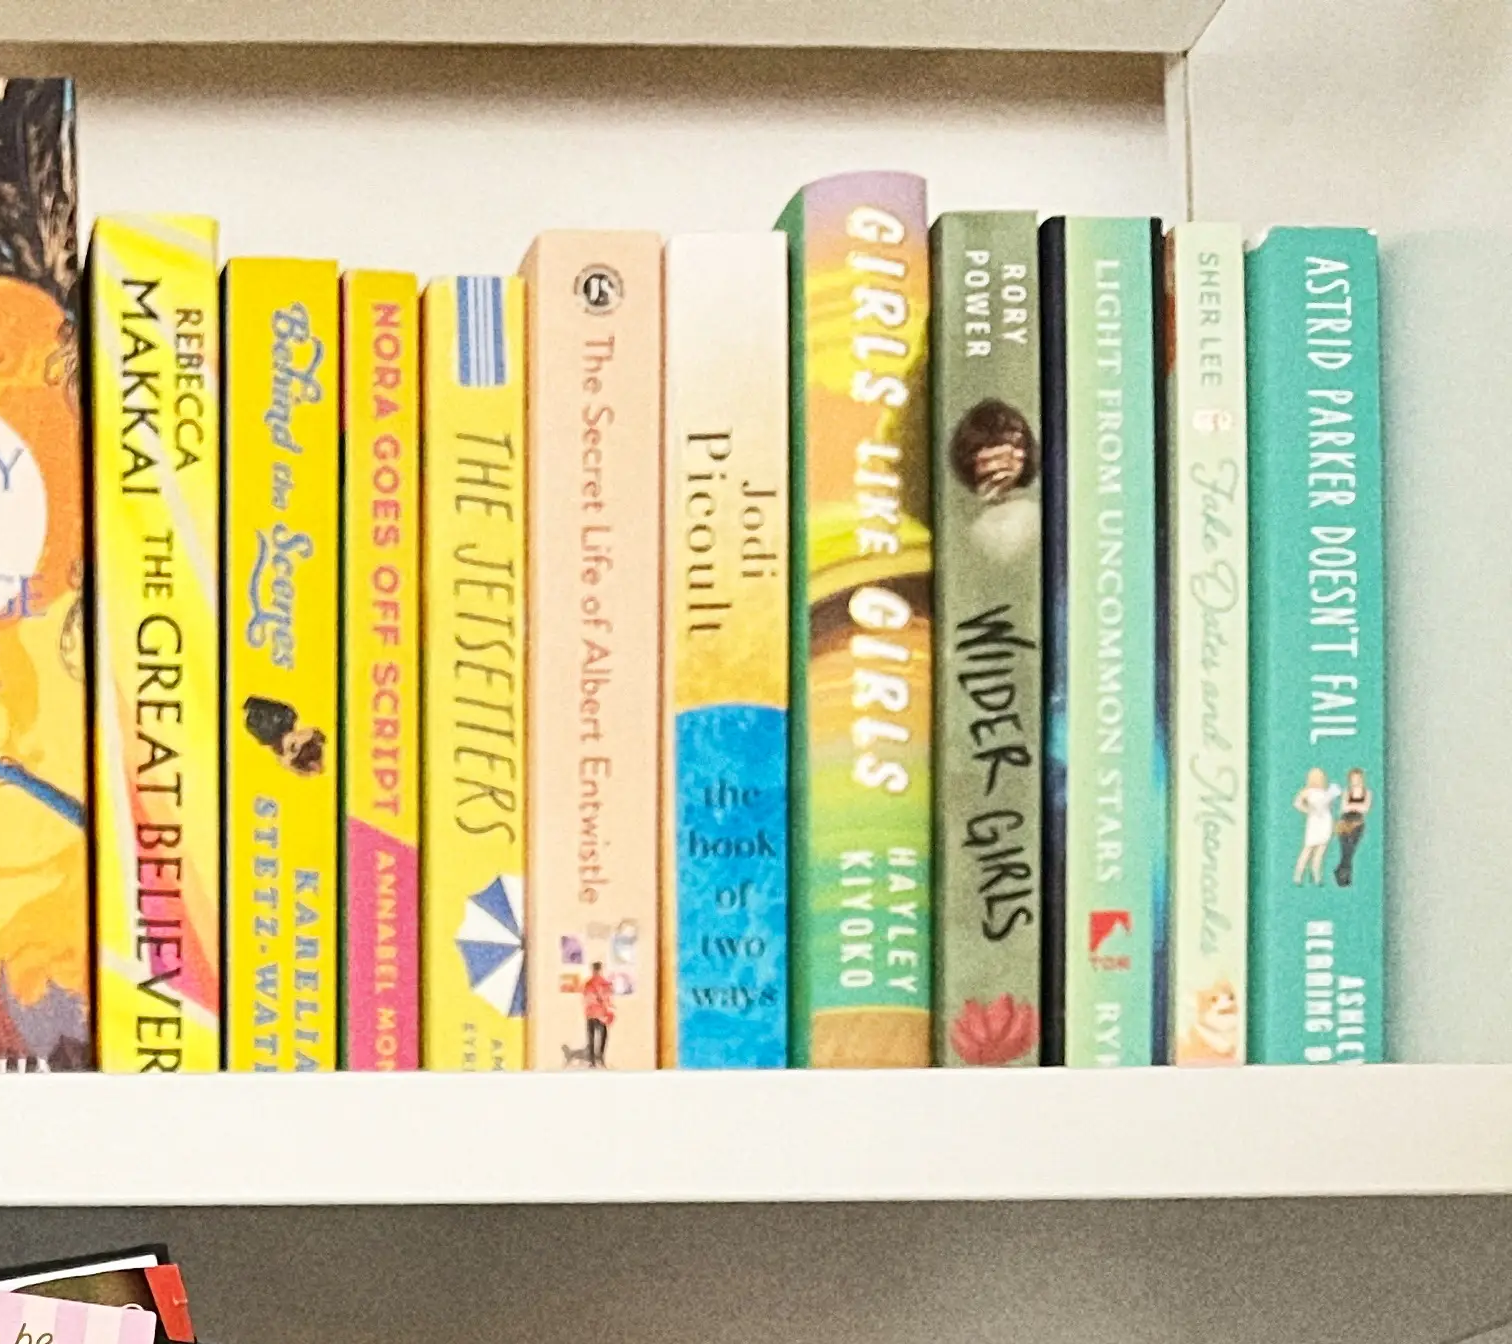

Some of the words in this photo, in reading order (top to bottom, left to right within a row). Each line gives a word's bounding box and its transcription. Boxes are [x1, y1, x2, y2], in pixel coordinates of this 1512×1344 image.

[845, 206, 910, 409] GIRLS
[964, 249, 993, 358] POWER
[1001, 262, 1029, 347] RORY
[1094, 257, 1122, 377] LIGHT
[1196, 251, 1221, 328] SHER
[1303, 255, 1354, 373] ASTRID
[121, 277, 162, 496] MAKKAI
[175, 307, 205, 474] REBECCA
[370, 303, 403, 421] NORA
[1200, 336, 1224, 387] LEE
[370, 435, 403, 550] GOES
[454, 433, 515, 523] THE
[853, 441, 901, 557] LIKE
[1094, 388, 1124, 496] FROM
[1306, 388, 1359, 510] PARKER
[143, 529, 175, 600] THE
[579, 525, 612, 585] Life
[685, 427, 732, 633] Picoult
[741, 480, 778, 580] Jodi
[370, 565, 402, 648] OFF
[1094, 510, 1125, 755] UNCOMMON
[136, 613, 183, 807] GREAT
[370, 663, 401, 817] SCRIPT
[453, 541, 516, 846] JETSETTERS
[848, 584, 912, 793] GIRLS
[955, 603, 1038, 798] WILDER
[1309, 674, 1360, 746] FAIL
[961, 808, 1035, 943] GIRLS
[1097, 766, 1125, 884] STARS
[840, 848, 874, 990] KIYOKO
[885, 846, 919, 995] HAYLEY
